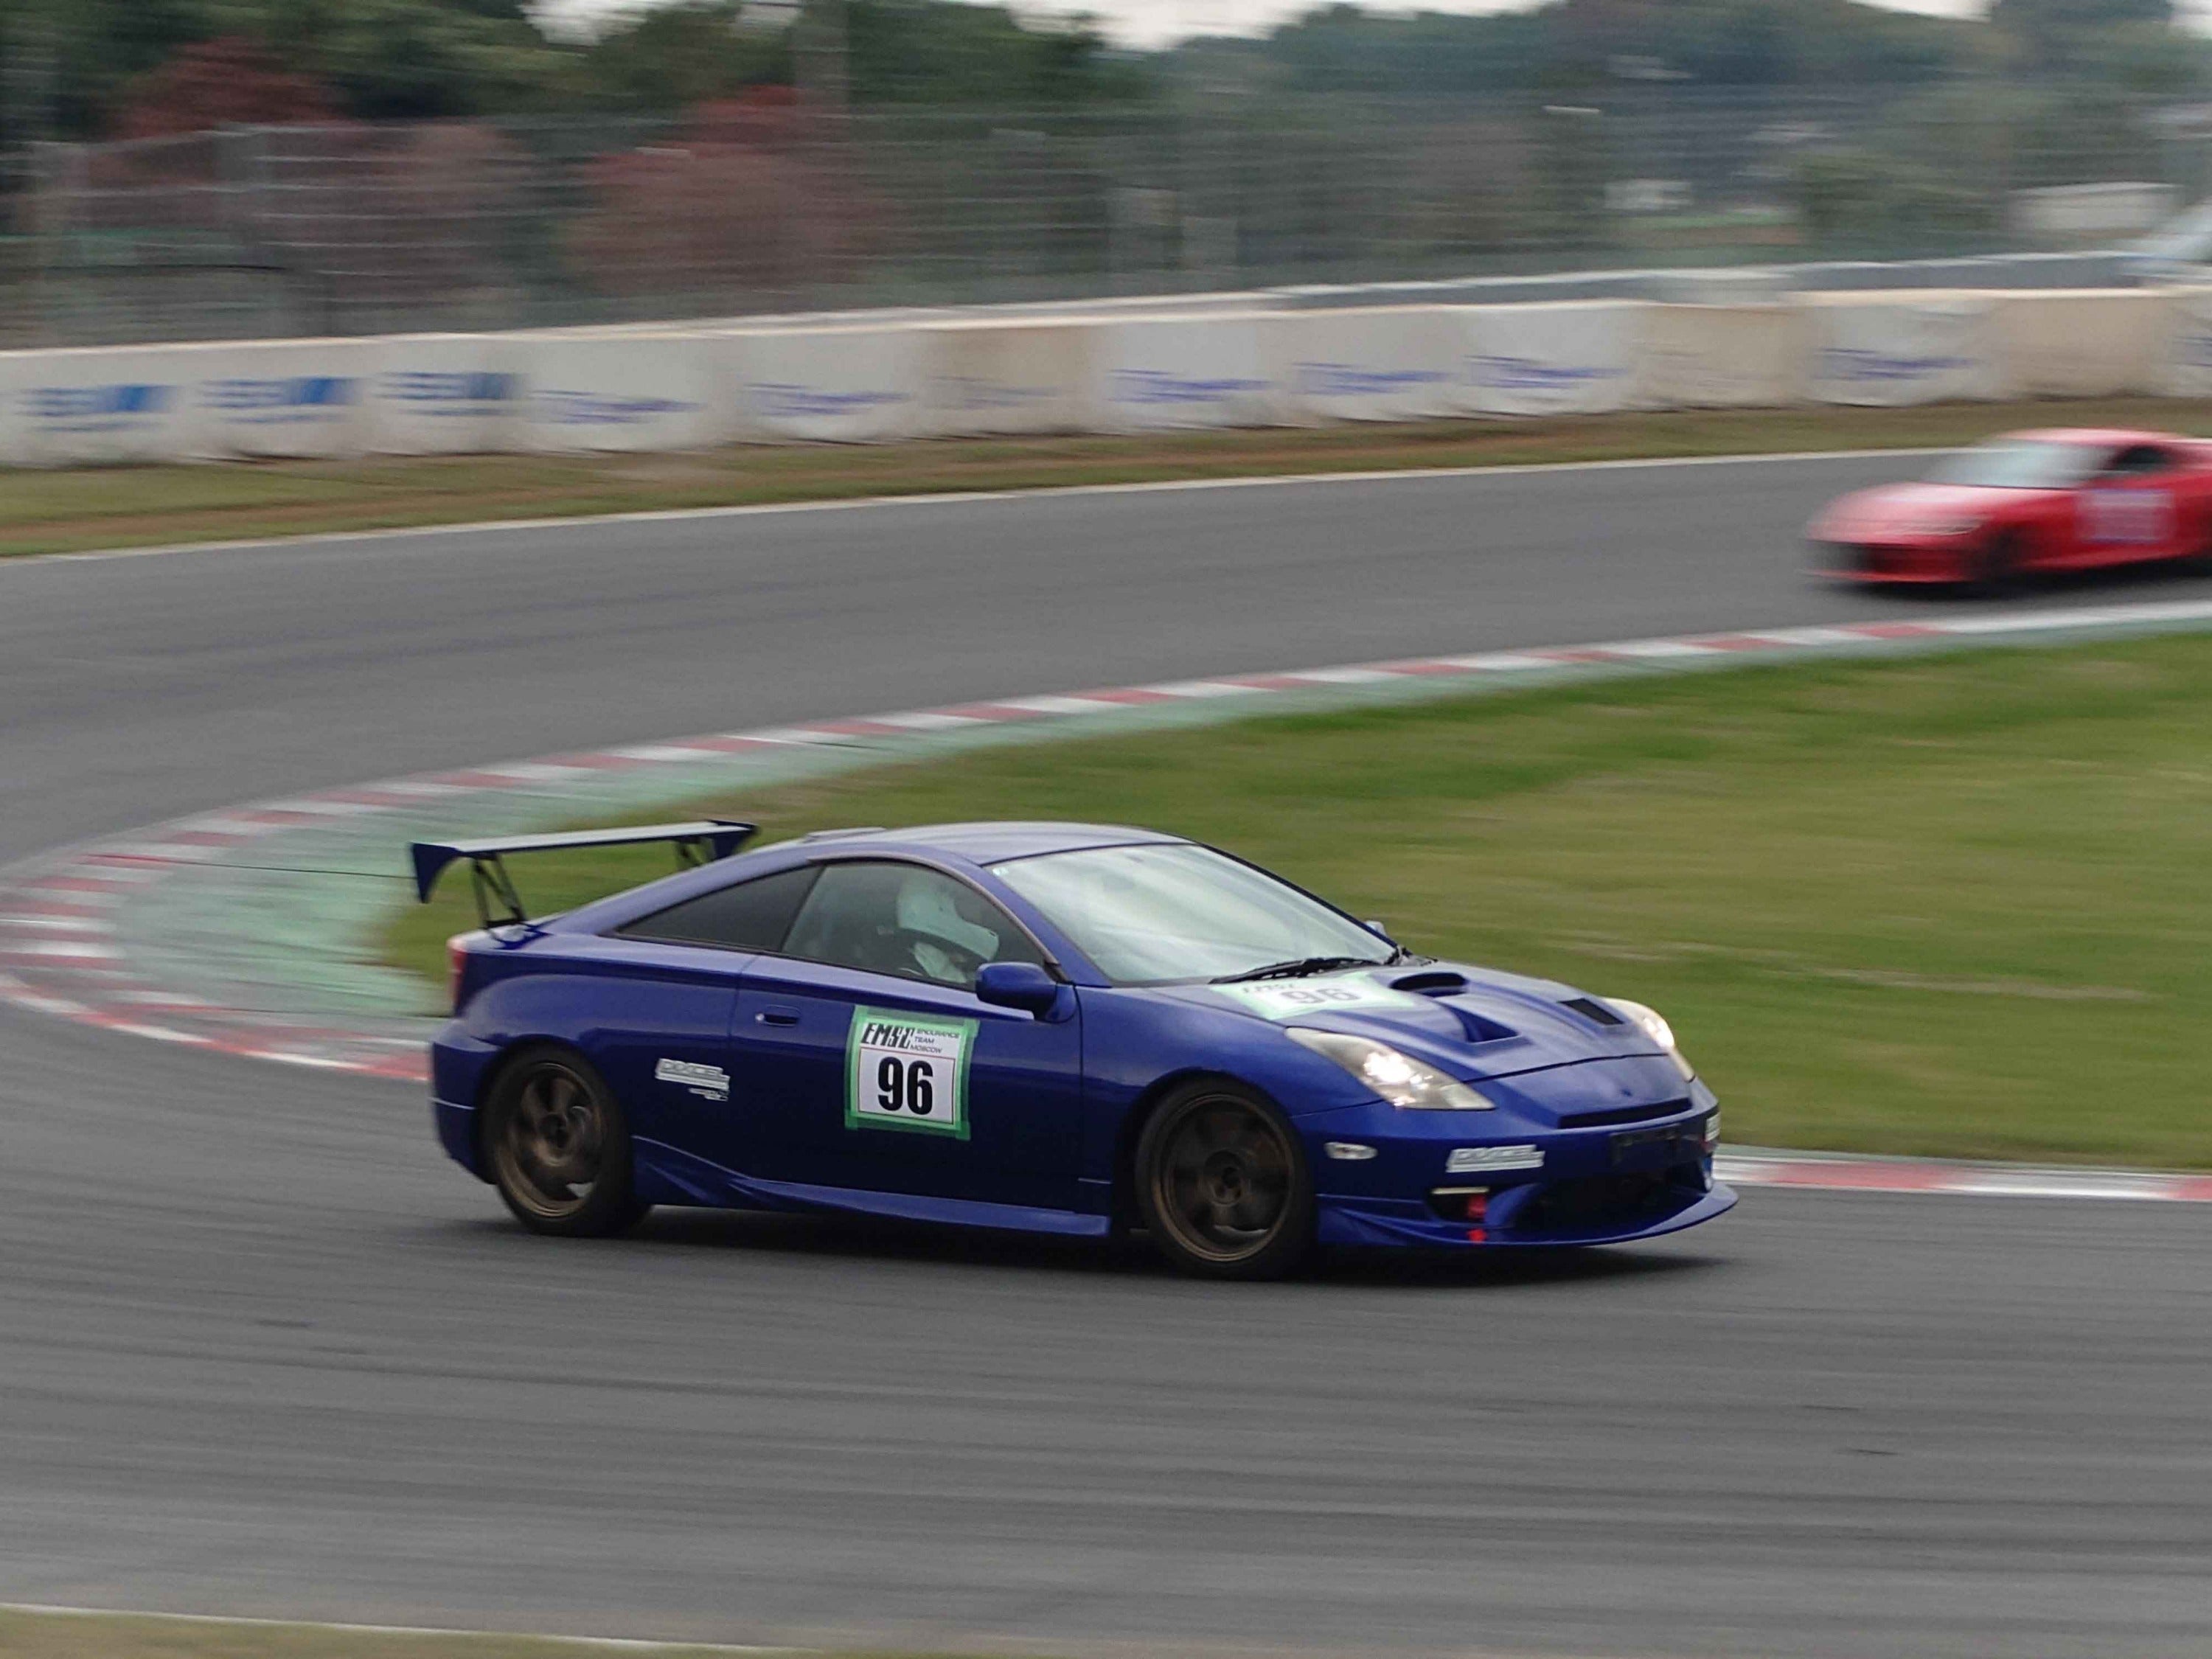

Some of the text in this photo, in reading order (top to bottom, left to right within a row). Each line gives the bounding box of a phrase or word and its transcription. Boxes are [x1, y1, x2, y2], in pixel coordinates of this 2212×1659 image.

[1280, 989, 1361, 1004] 96
[916, 1028, 961, 1039] ENDURANCE
[914, 1035, 935, 1044] TEAM
[910, 1044, 943, 1054] MOSCOW
[877, 1056, 934, 1116] 96
